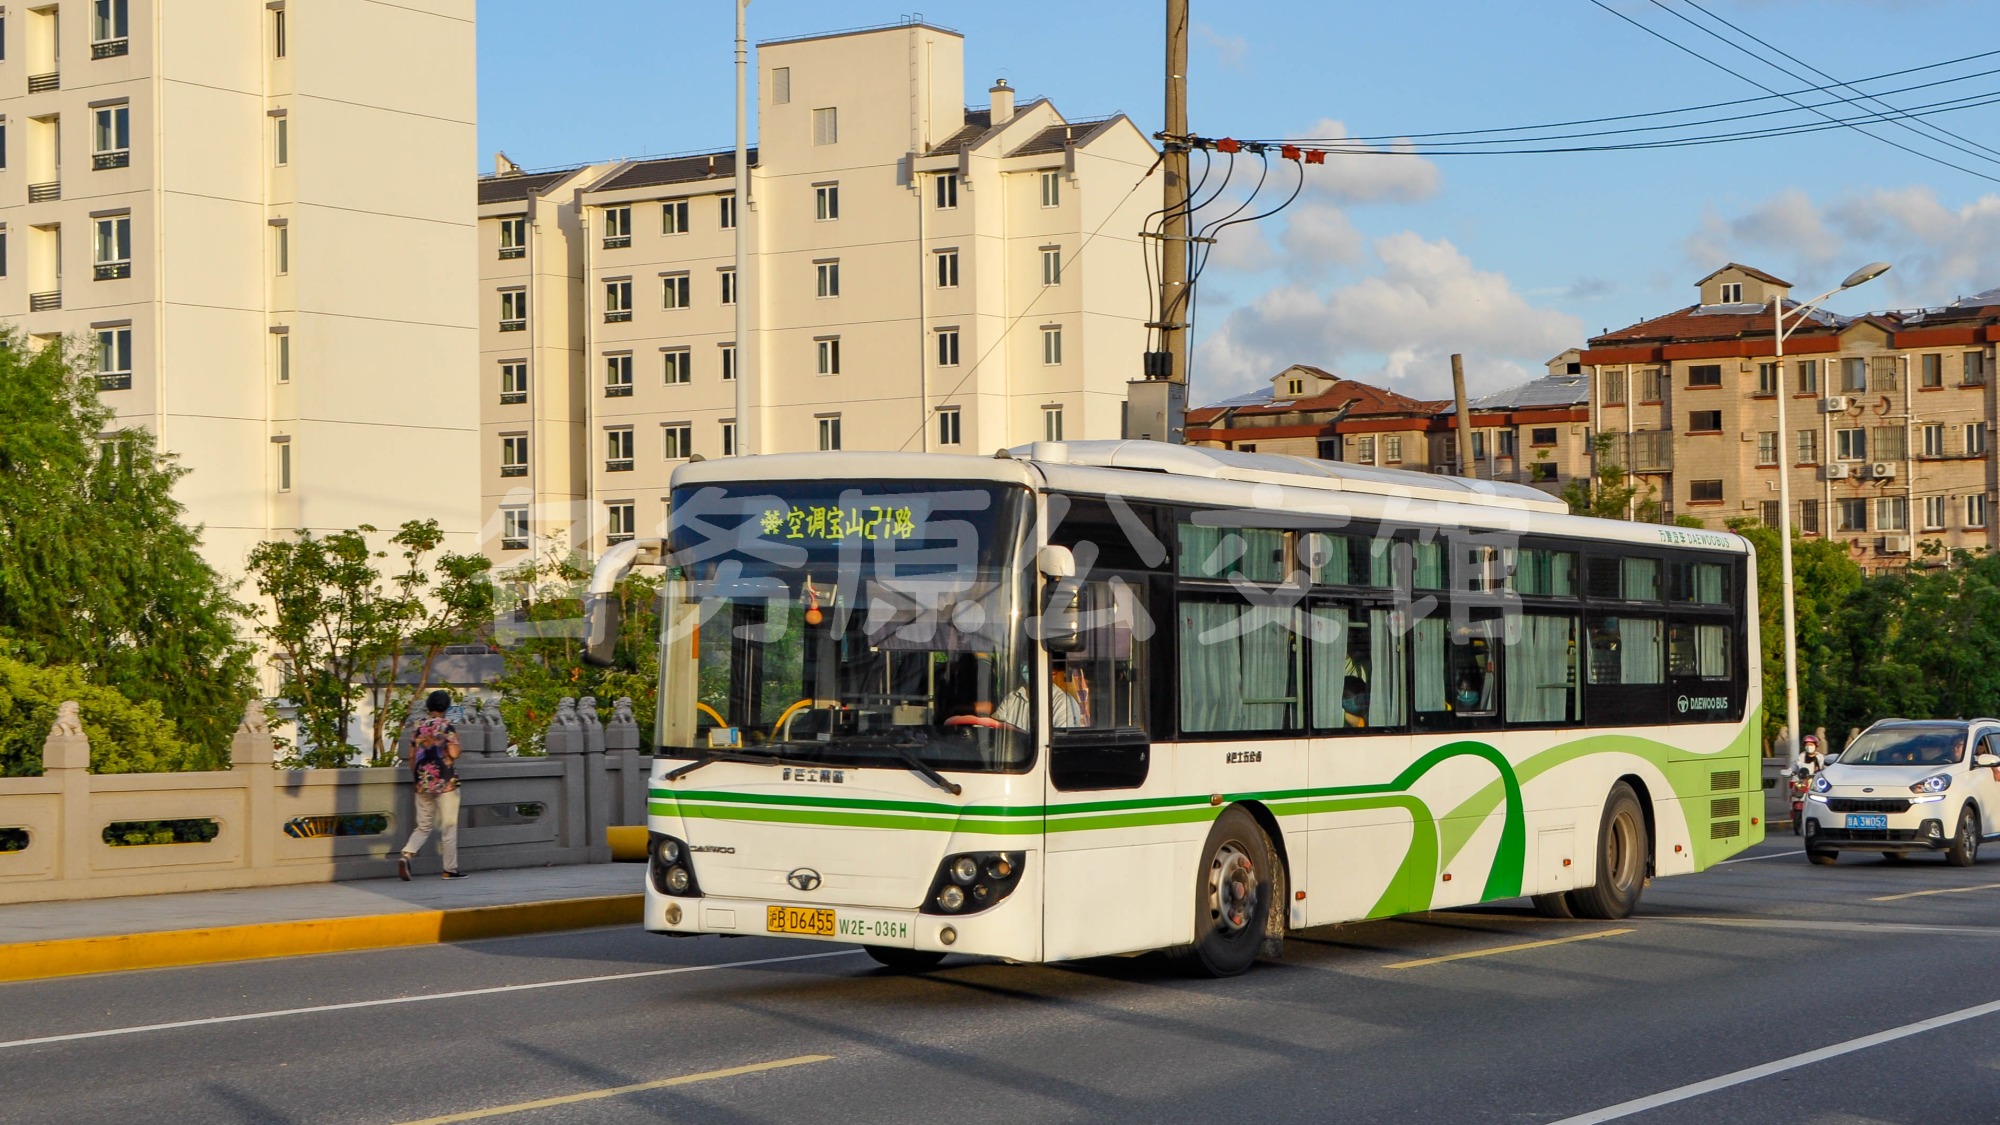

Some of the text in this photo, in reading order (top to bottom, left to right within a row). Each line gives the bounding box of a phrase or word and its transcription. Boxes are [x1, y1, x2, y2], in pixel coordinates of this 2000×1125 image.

[786, 506, 915, 539] 空调宝山21路
[1690, 696, 1728, 710] DAEWOO BUS
